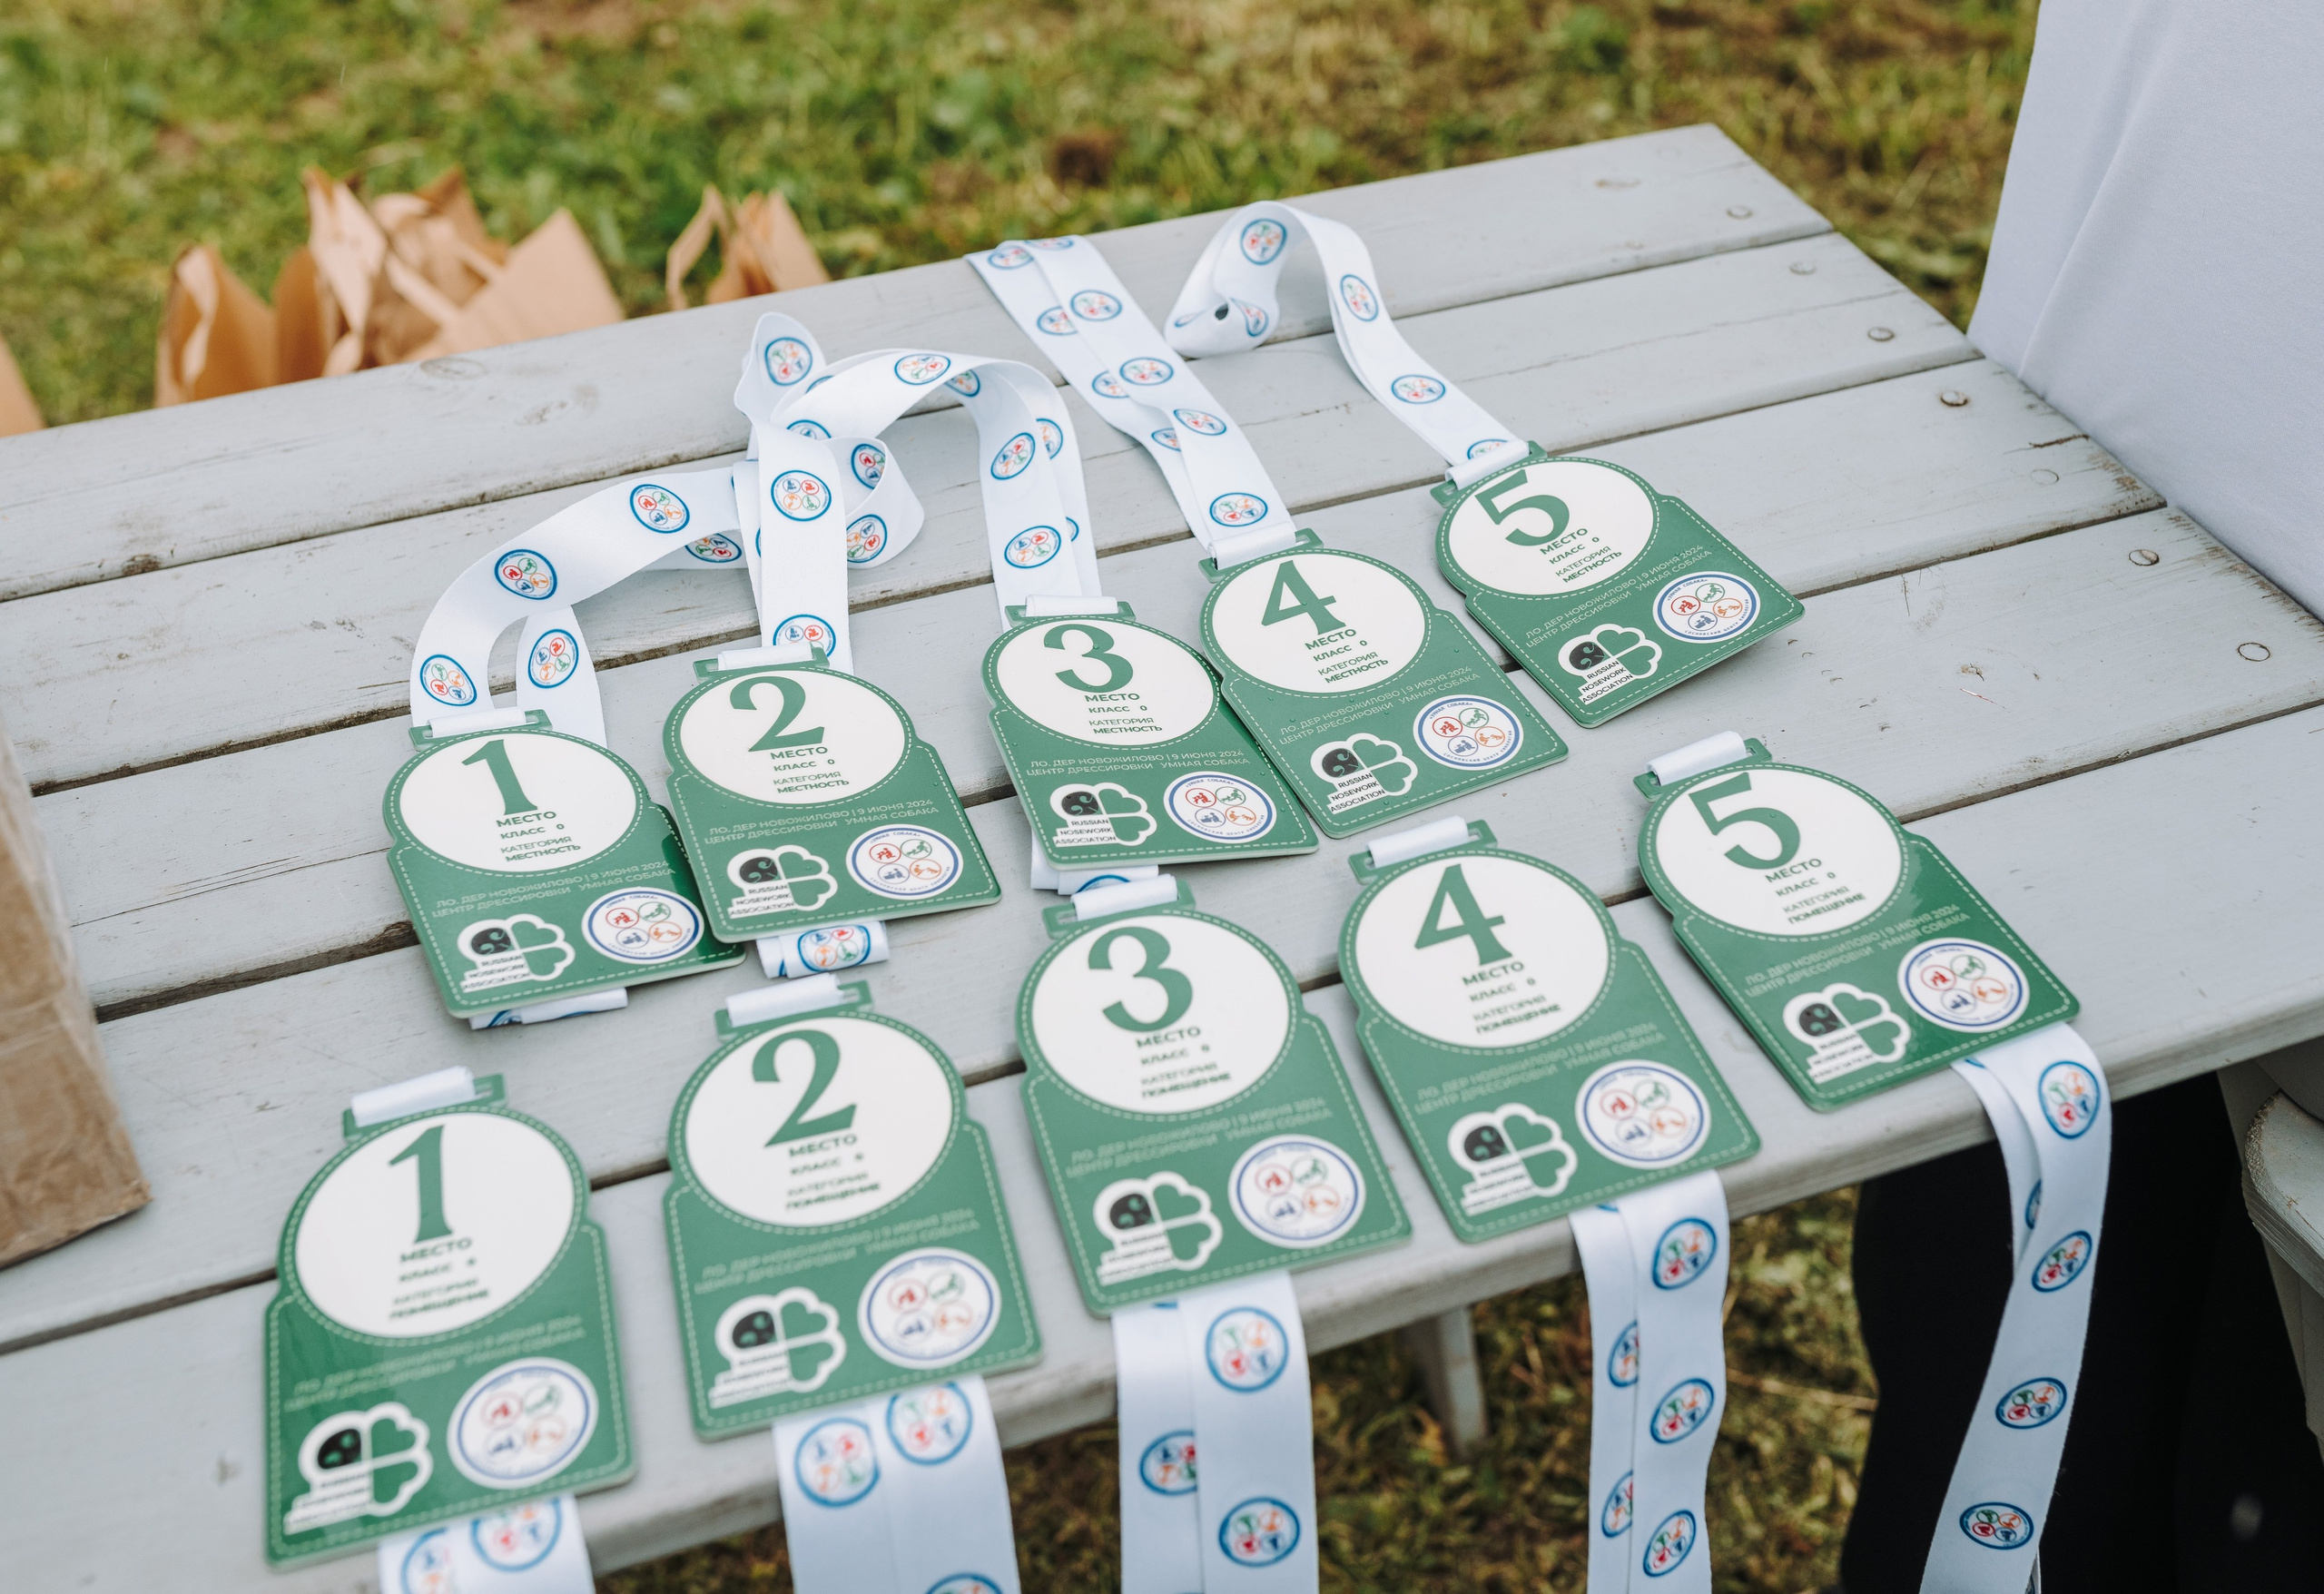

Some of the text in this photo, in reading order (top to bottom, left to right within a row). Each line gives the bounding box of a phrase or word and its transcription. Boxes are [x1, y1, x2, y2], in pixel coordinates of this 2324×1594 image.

[1473, 468, 1569, 546] 5
[1539, 526, 1590, 555] МЕСТО
[1548, 543, 1586, 565] КЛАСС
[1554, 545, 1611, 576] КАТЕГОРИЯ
[1561, 549, 1622, 583] МЕСТНОСТЬ
[1261, 560, 1345, 635] 4
[1524, 548, 1712, 649] ЦЕНТР ДРЕССИРОВКИ УМНАЯ СОБАКА
[1541, 615, 1565, 630] ДЕР
[1563, 577, 1638, 618] НОВОЖИЛОВО
[1640, 571, 1650, 579] 9
[1648, 556, 1681, 575] ИЮНЯ
[1679, 543, 1705, 559] 2024
[1304, 627, 1358, 650] МЕСТО
[1043, 624, 1133, 693] 3
[1312, 644, 1353, 662] КЛАСС
[1317, 651, 1378, 675] КАТЕГОРИЯ
[1324, 657, 1389, 684] МЕСТНОСТЬ
[1581, 666, 1627, 693] NOSEWORK
[1586, 660, 1620, 679] RUSSIAN
[1083, 692, 1141, 702] МЕСТО
[1298, 715, 1323, 729] ДЕР
[1321, 689, 1402, 721] НОВОЖИЛОВО
[1404, 684, 1414, 693] 9
[1413, 674, 1448, 689] ИЮНЯ
[1446, 664, 1473, 678] 2024
[1581, 673, 1633, 703] ASSOCIATION
[729, 675, 824, 752] 2
[1088, 716, 1154, 726] КАТЕГОРИЯ
[1277, 672, 1481, 746] ЦЕНТР ДРЕССИРОВКИ УМНАЯ СОБАКА
[1092, 724, 1163, 733] МЕСТНОСТЬ
[769, 745, 829, 760] МЕСТО
[1051, 759, 1077, 767] ДЕР
[1078, 754, 1165, 764] НОВОЖИЛОВО
[1180, 751, 1216, 759] ИЮНЯ
[462, 739, 537, 815] 1
[773, 760, 817, 772] КЛАСС
[773, 771, 842, 785] КАТЕГОРИЯ
[1025, 757, 1250, 777] ЦЕНТР ДРЕССИРОВКИ УМНАЯ СОБАКА
[776, 778, 850, 793] МЕСТНОСТЬ
[1330, 780, 1380, 802] NOSEWORK
[1337, 772, 1373, 789] RUSSIAN
[1328, 788, 1385, 812] ASSOCIATION
[495, 811, 557, 828] МЕСТО
[704, 806, 939, 845] ЦЕНТР ДРЕССИРОВКИ УМНАЯ СОБАКА
[731, 822, 758, 832] ДЕР
[759, 810, 850, 828] НОВОЖИЛОВО
[856, 807, 865, 815] 9
[866, 802, 904, 813] ИЮНЯ
[905, 798, 934, 808] 2024
[1070, 818, 1109, 826] RUSSIAN
[1688, 772, 1799, 870] 5
[499, 826, 547, 840] КЛАСС
[1054, 835, 1117, 844] ASSOCIATION
[1059, 826, 1113, 835] NOSEWORK
[500, 835, 572, 853] КАТЕГОРИЯ
[504, 842, 581, 861] МЕСТНОСТЬ
[459, 892, 487, 904] ДЕР
[487, 875, 584, 898] НОВОЖИЛОВО
[600, 865, 639, 878] ИЮНЯ
[640, 860, 670, 871] 2024
[1763, 856, 1824, 883] МЕСТО
[430, 867, 675, 919] ЦЕНТР ДРЕССИРОВКИ УМНАЯ СОБАКА
[1774, 876, 1820, 897] КЛАСС
[1781, 885, 1850, 914] КАТЕГОРИЯ
[1787, 891, 1866, 925] ПОМЕЩЕНИЕ
[1931, 902, 1962, 919] 2024
[1414, 863, 1511, 965] 4
[1920, 911, 1971, 935] СОБАКА
[1088, 926, 1192, 1032] 3
[1461, 959, 1526, 987] МЕСТО
[1468, 982, 1518, 1003] КЛАСС
[1135, 1025, 1202, 1049] МЕСТО
[752, 1028, 856, 1146] 2
[787, 1133, 858, 1159] МЕСТО
[389, 1125, 452, 1243] 1
